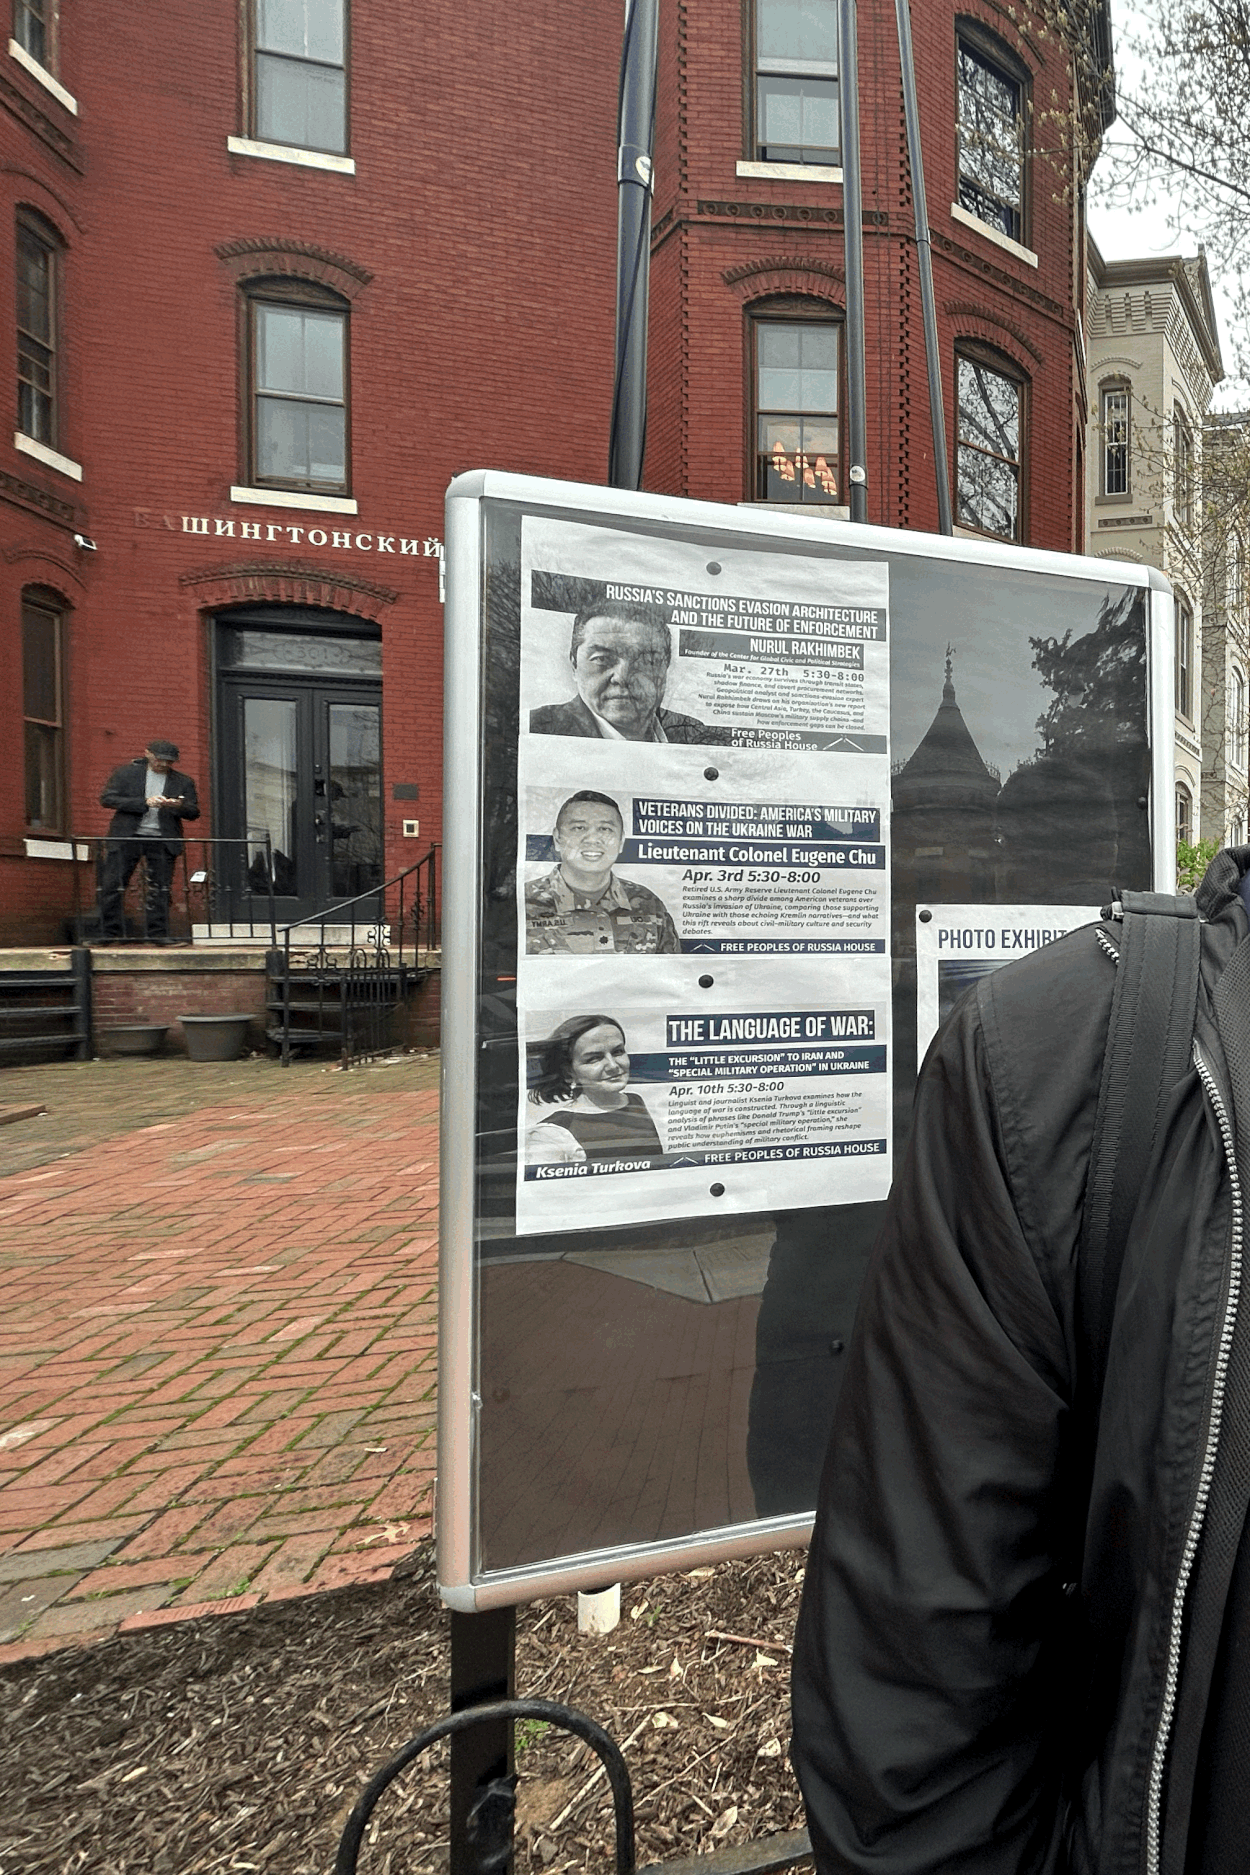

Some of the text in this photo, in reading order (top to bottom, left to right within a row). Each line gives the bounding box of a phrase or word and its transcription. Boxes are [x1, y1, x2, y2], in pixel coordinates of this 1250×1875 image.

[667, 591, 735, 611] SANCTIONS
[739, 598, 788, 616] EVASION
[792, 603, 878, 624] ARCHITECTURE
[671, 610, 878, 640] AND THE FUTURE OF ENFORCEMENT
[751, 638, 860, 659] NURUL RAKHIMBEK
[723, 664, 865, 682] Mar. 27th 5:30-8:00
[732, 728, 801, 742] Free Peoples
[732, 739, 818, 750] of Russia House
[639, 802, 702, 818] VETERANS
[707, 804, 756, 820] DIVIDED:
[824, 808, 876, 824] MILITARY
[639, 820, 812, 838] VOICES ON THE UKRAINE WAR
[639, 844, 876, 867] Lieutenant Colonel Eugene Chu
[682, 869, 821, 884] Apr. 3rd 5:30-8:00
[721, 943, 875, 951] FREE PEOPLES OF RUSSIA HOUSE
[938, 929, 995, 949] PHOTO
[669, 1016, 873, 1042] THE LANGUAGE OF WAR:
[669, 1057, 686, 1066] THE
[787, 1053, 799, 1062] TO
[801, 1052, 822, 1061] IRAN
[825, 1052, 844, 1060] AND
[715, 1066, 756, 1076] MILITARY
[819, 1063, 827, 1072] IN
[830, 1061, 870, 1071] UKRAINE
[669, 1081, 785, 1098] Apr. 10th 5:30-8:00
[705, 1143, 880, 1163] FREE PEOPLES OF RUSSIA HOUSE
[536, 1162, 651, 1178] Ksenia Turkova
